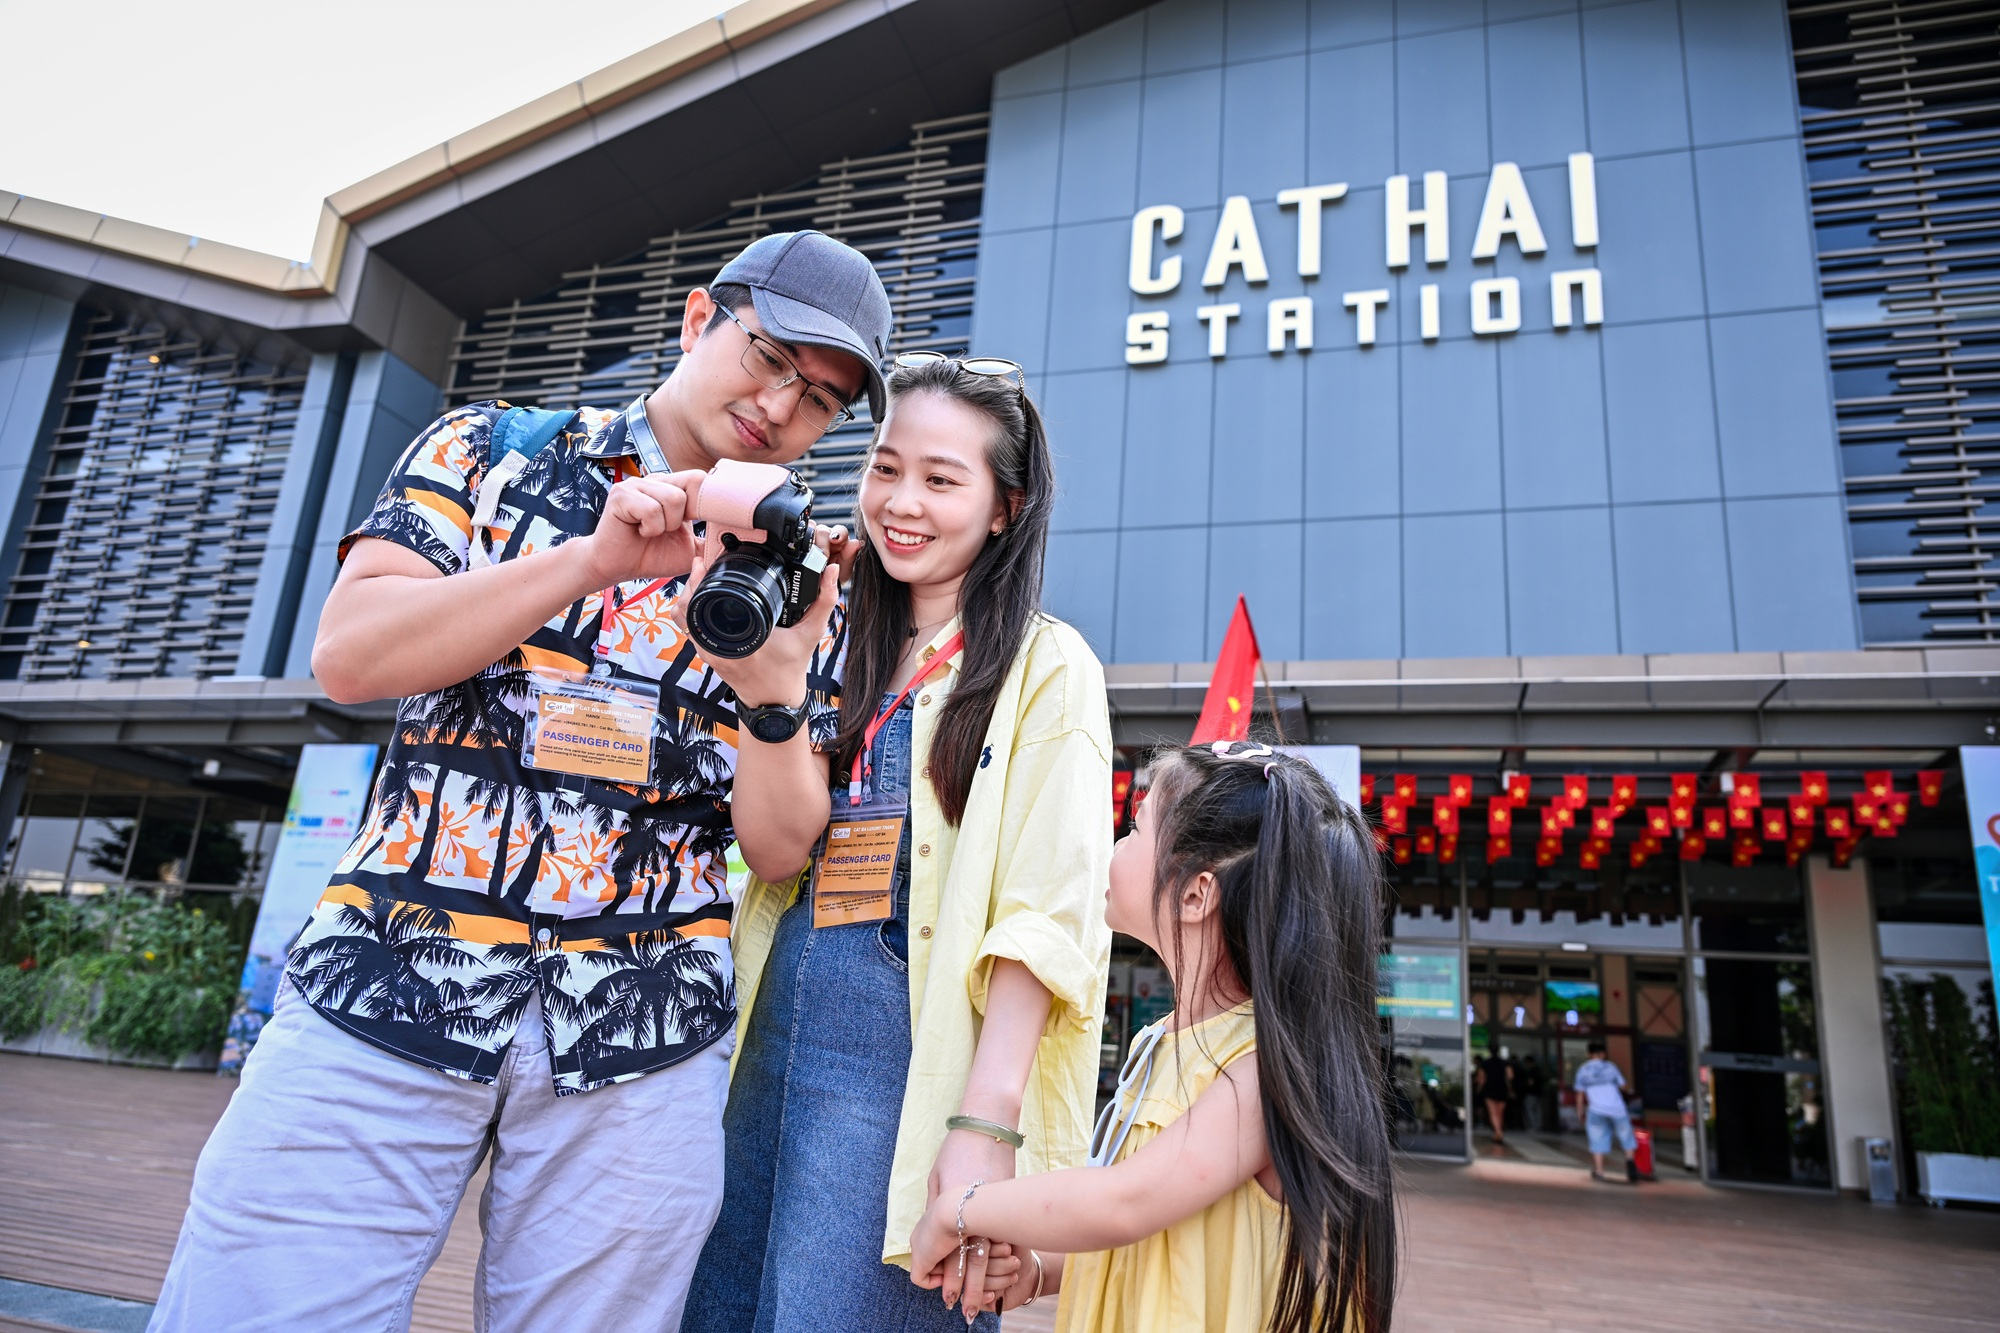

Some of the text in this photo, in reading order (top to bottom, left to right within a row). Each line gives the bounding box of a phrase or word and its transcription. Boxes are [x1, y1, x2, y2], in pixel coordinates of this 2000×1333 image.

[1124, 267, 1605, 365] STATION
[790, 570, 802, 604] FUJIFILM
[600, 709, 623, 717] LUXURY
[623, 711, 643, 720] TRANS
[542, 730, 610, 748] PASSENGER
[612, 741, 643, 753] CARD
[827, 853, 892, 865] PASSENGER CARD
[1513, 1006, 1525, 1029] 7
